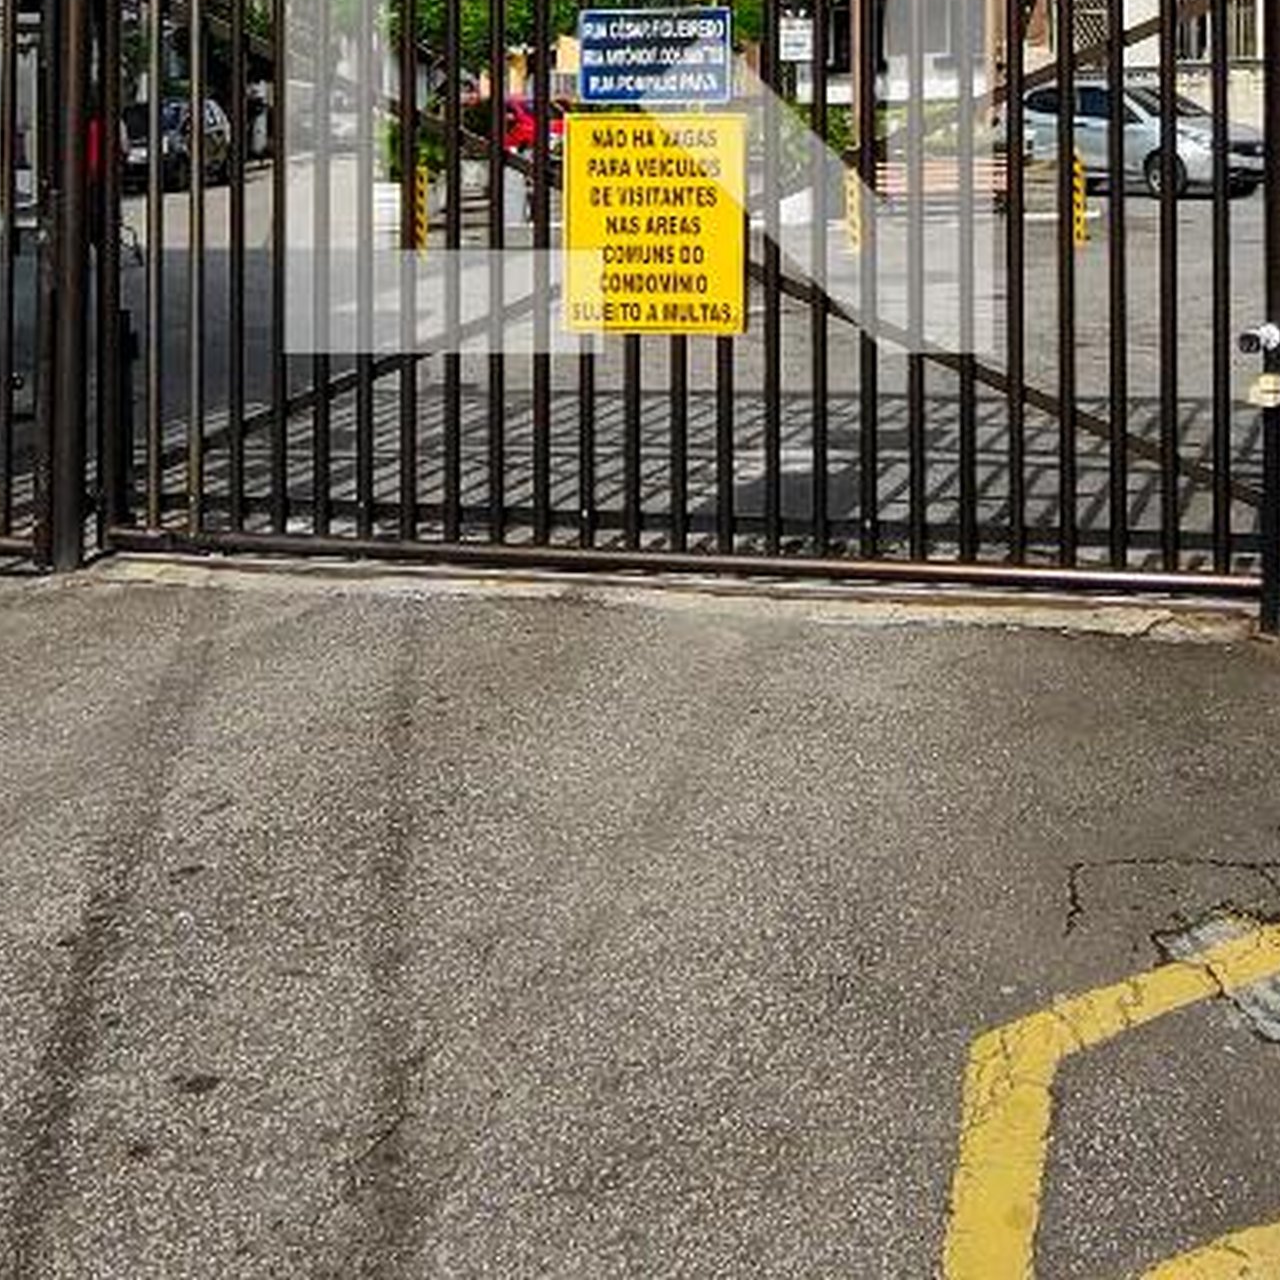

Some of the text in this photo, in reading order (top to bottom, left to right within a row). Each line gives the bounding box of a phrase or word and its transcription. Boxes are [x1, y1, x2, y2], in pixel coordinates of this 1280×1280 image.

[659, 129, 718, 148] VAGAS
[588, 158, 631, 177] PARA
[590, 186, 717, 207] DE VISITANTES
[606, 217, 640, 235] NAS
[603, 245, 704, 264] COMUNS DO
